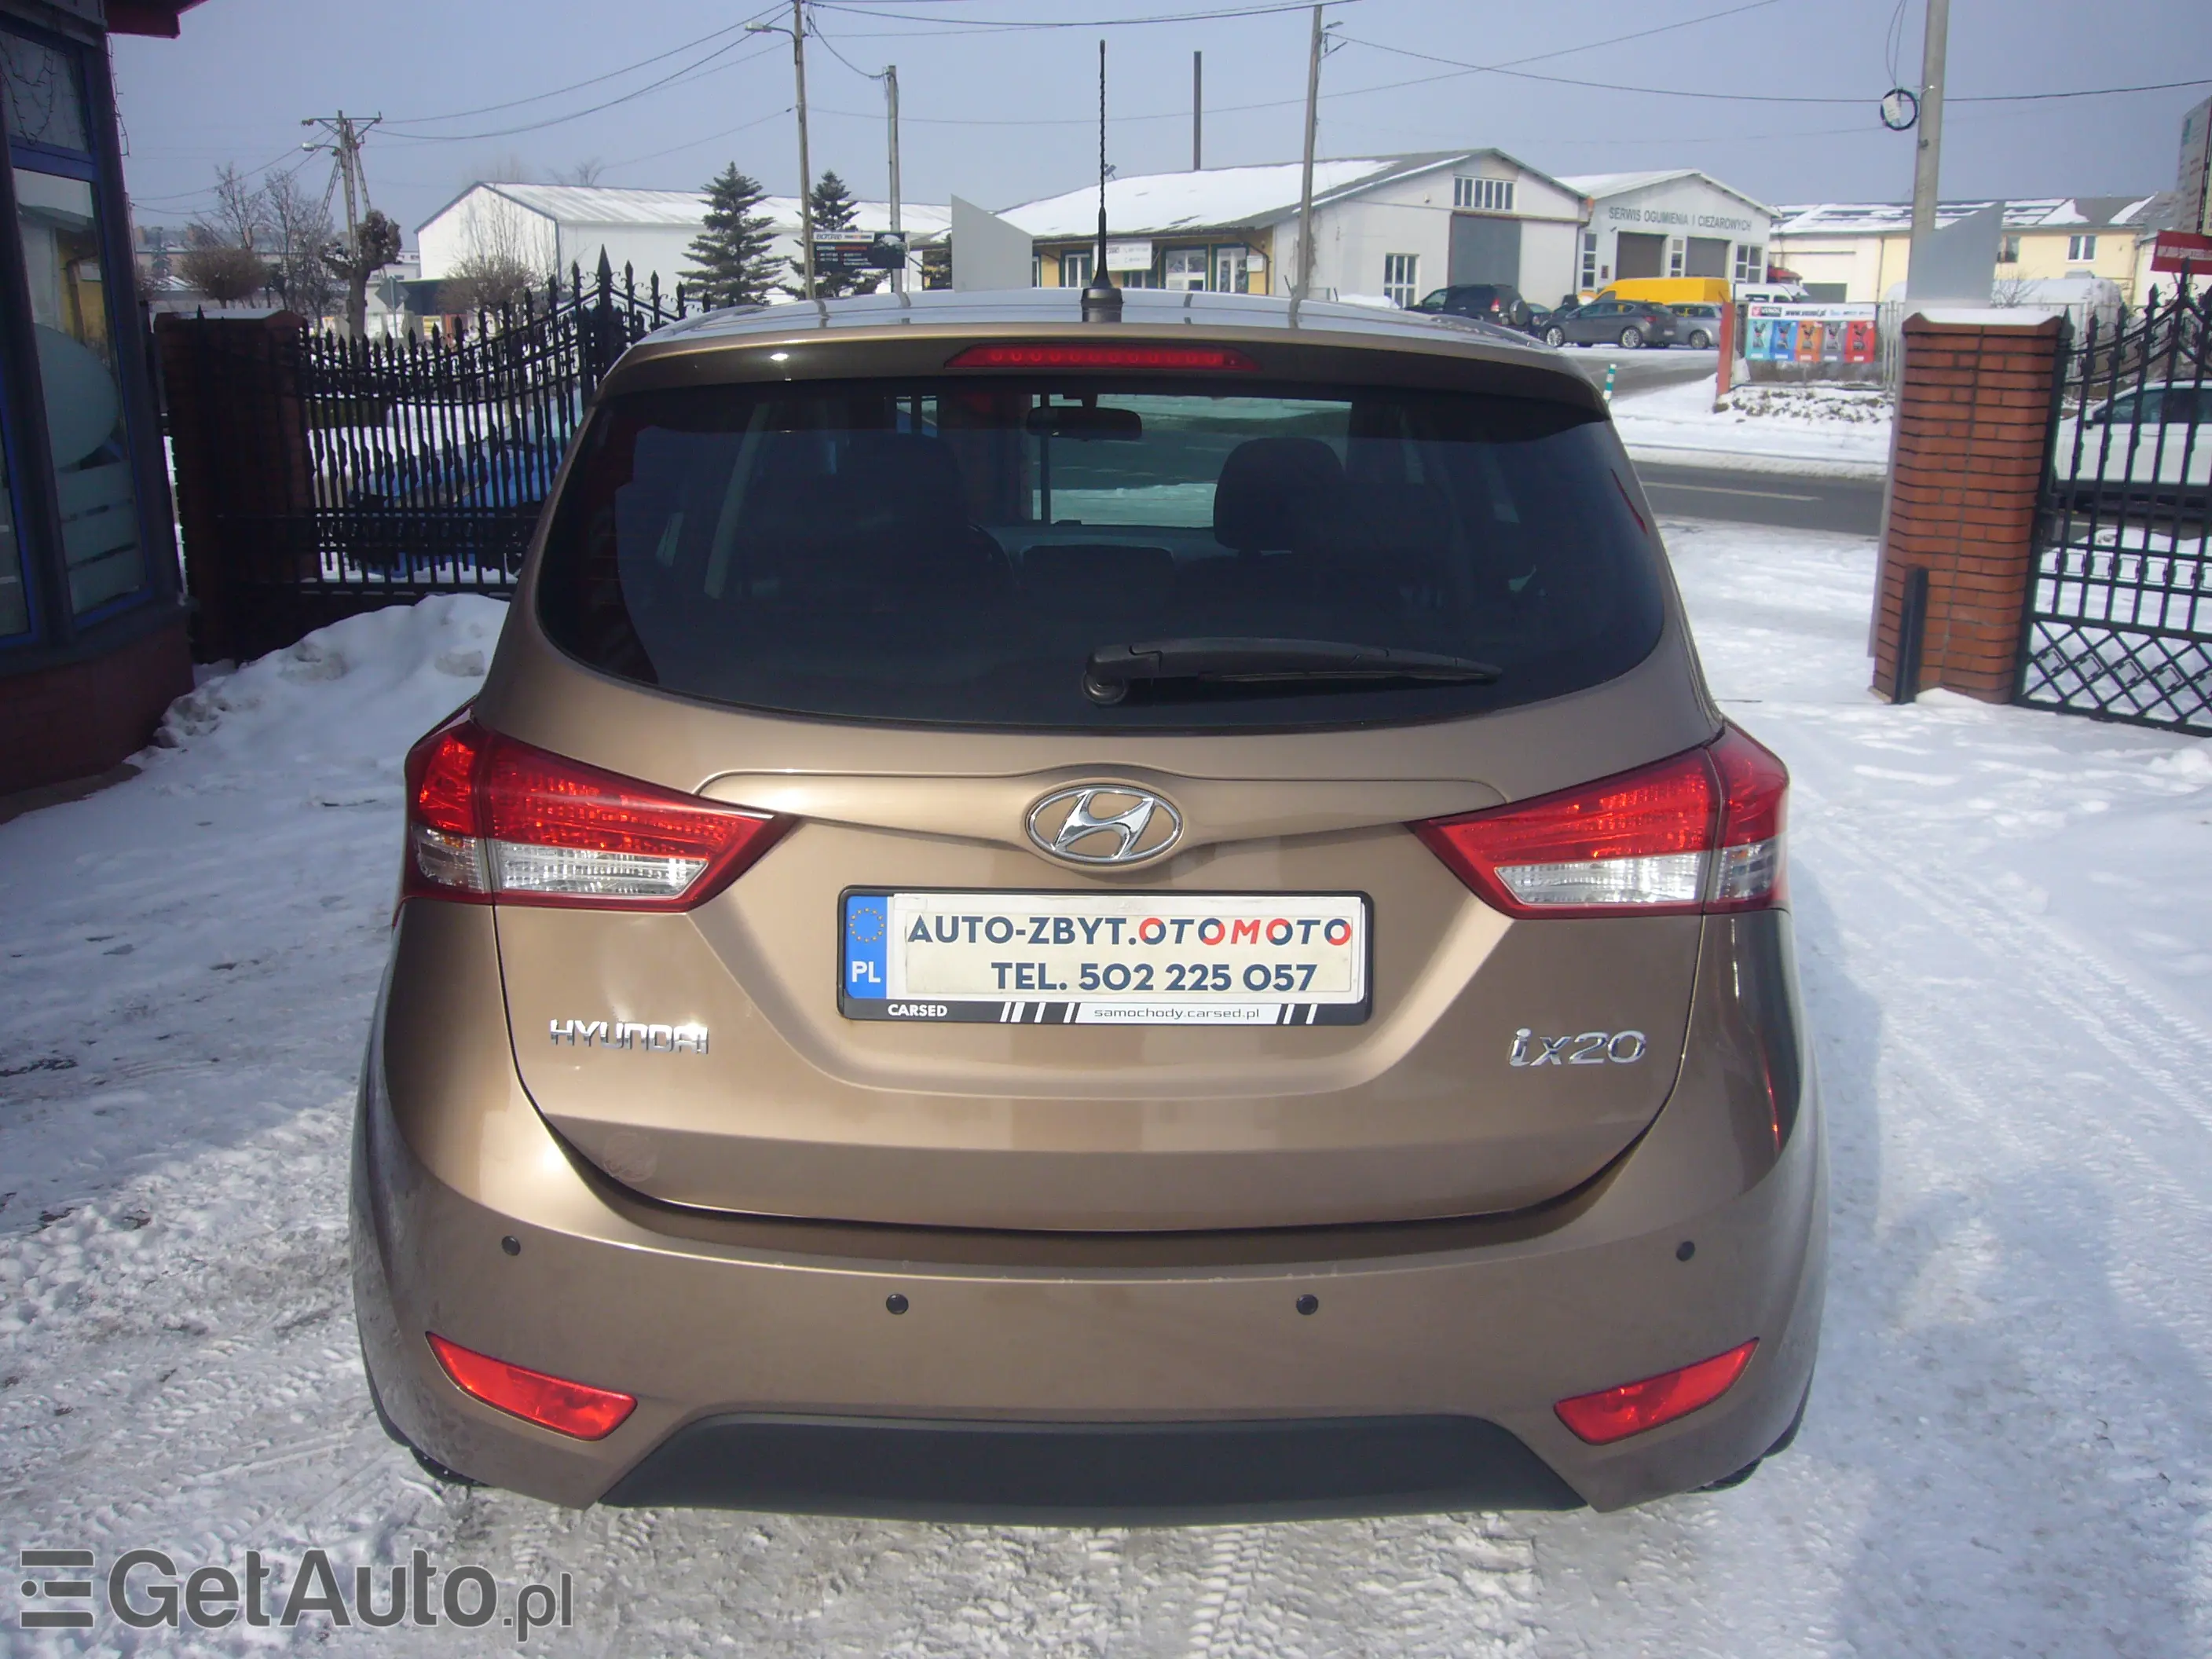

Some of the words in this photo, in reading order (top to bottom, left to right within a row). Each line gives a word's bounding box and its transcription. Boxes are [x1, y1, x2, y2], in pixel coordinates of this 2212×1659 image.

[1609, 207, 1641, 222] SERWIS
[1644, 210, 1688, 225] OGUMIENIA
[907, 914, 1351, 946] AUTO-ZBYT.OTOMOTO
[851, 960, 881, 983] PL
[991, 962, 1068, 991] TEL.
[1079, 963, 1155, 991] 502
[1164, 963, 1232, 991] 225
[1243, 964, 1318, 991] 057
[888, 1004, 947, 1018] CARSED
[1094, 1008, 1260, 1020] samochody.carsed.pl
[550, 1018, 709, 1054] HYUNDAI
[1509, 1027, 1646, 1067] ix20
